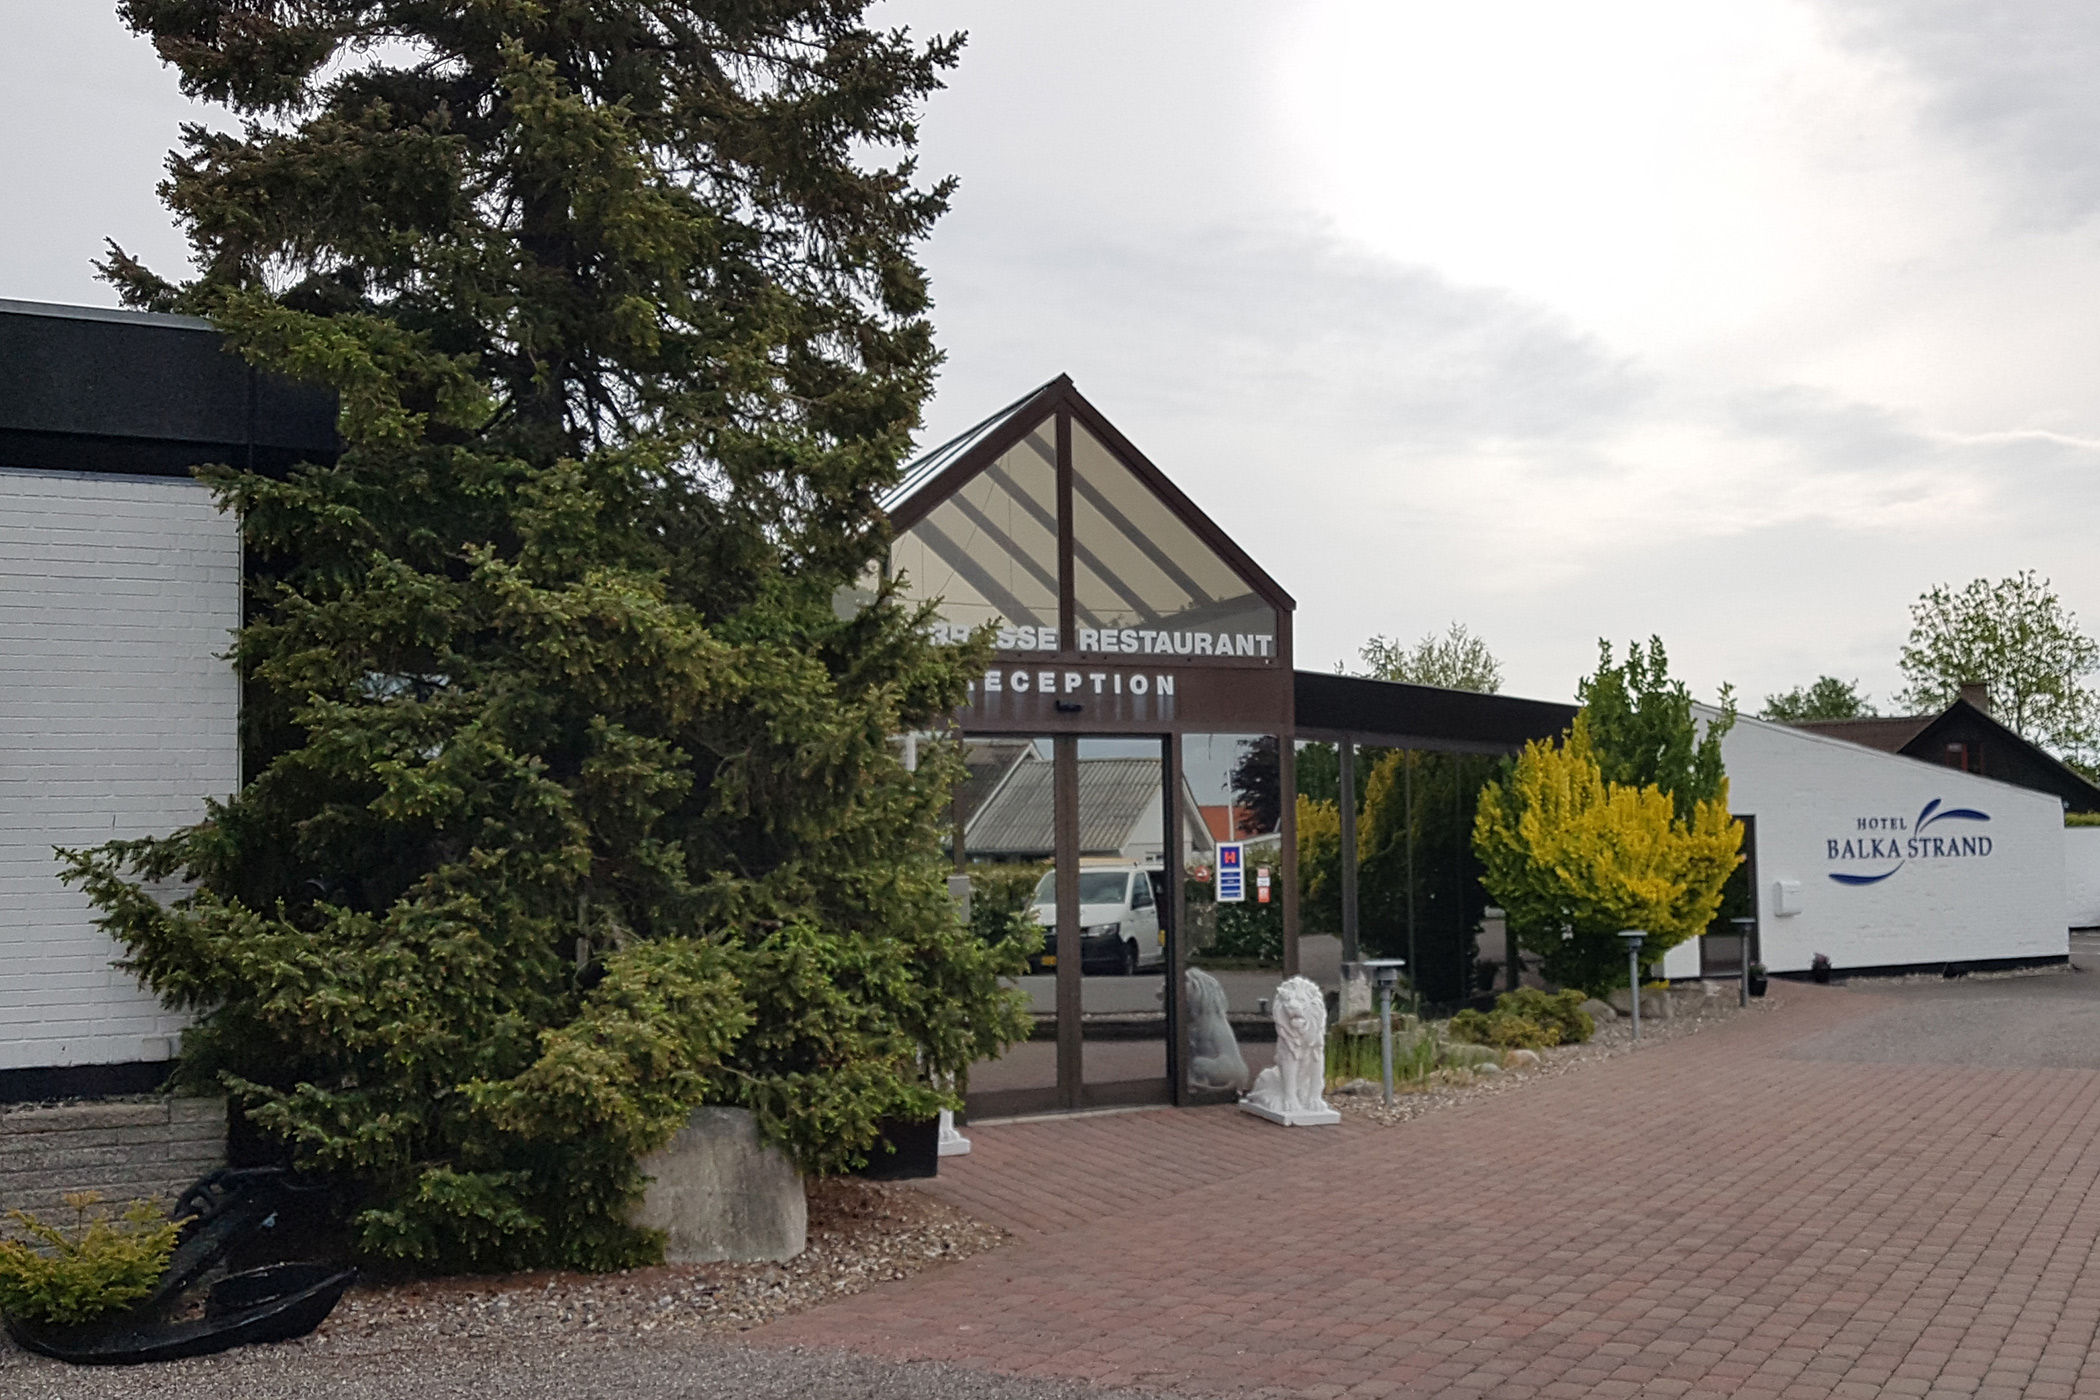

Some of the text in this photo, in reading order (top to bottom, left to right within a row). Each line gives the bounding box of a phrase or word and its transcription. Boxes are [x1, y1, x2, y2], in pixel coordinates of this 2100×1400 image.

[1079, 628, 1272, 656] RESTAURANT
[968, 669, 1174, 696] ECEPTION
[1857, 817, 1907, 831] HOTEL
[1827, 836, 1993, 860] BALKA STRAND
